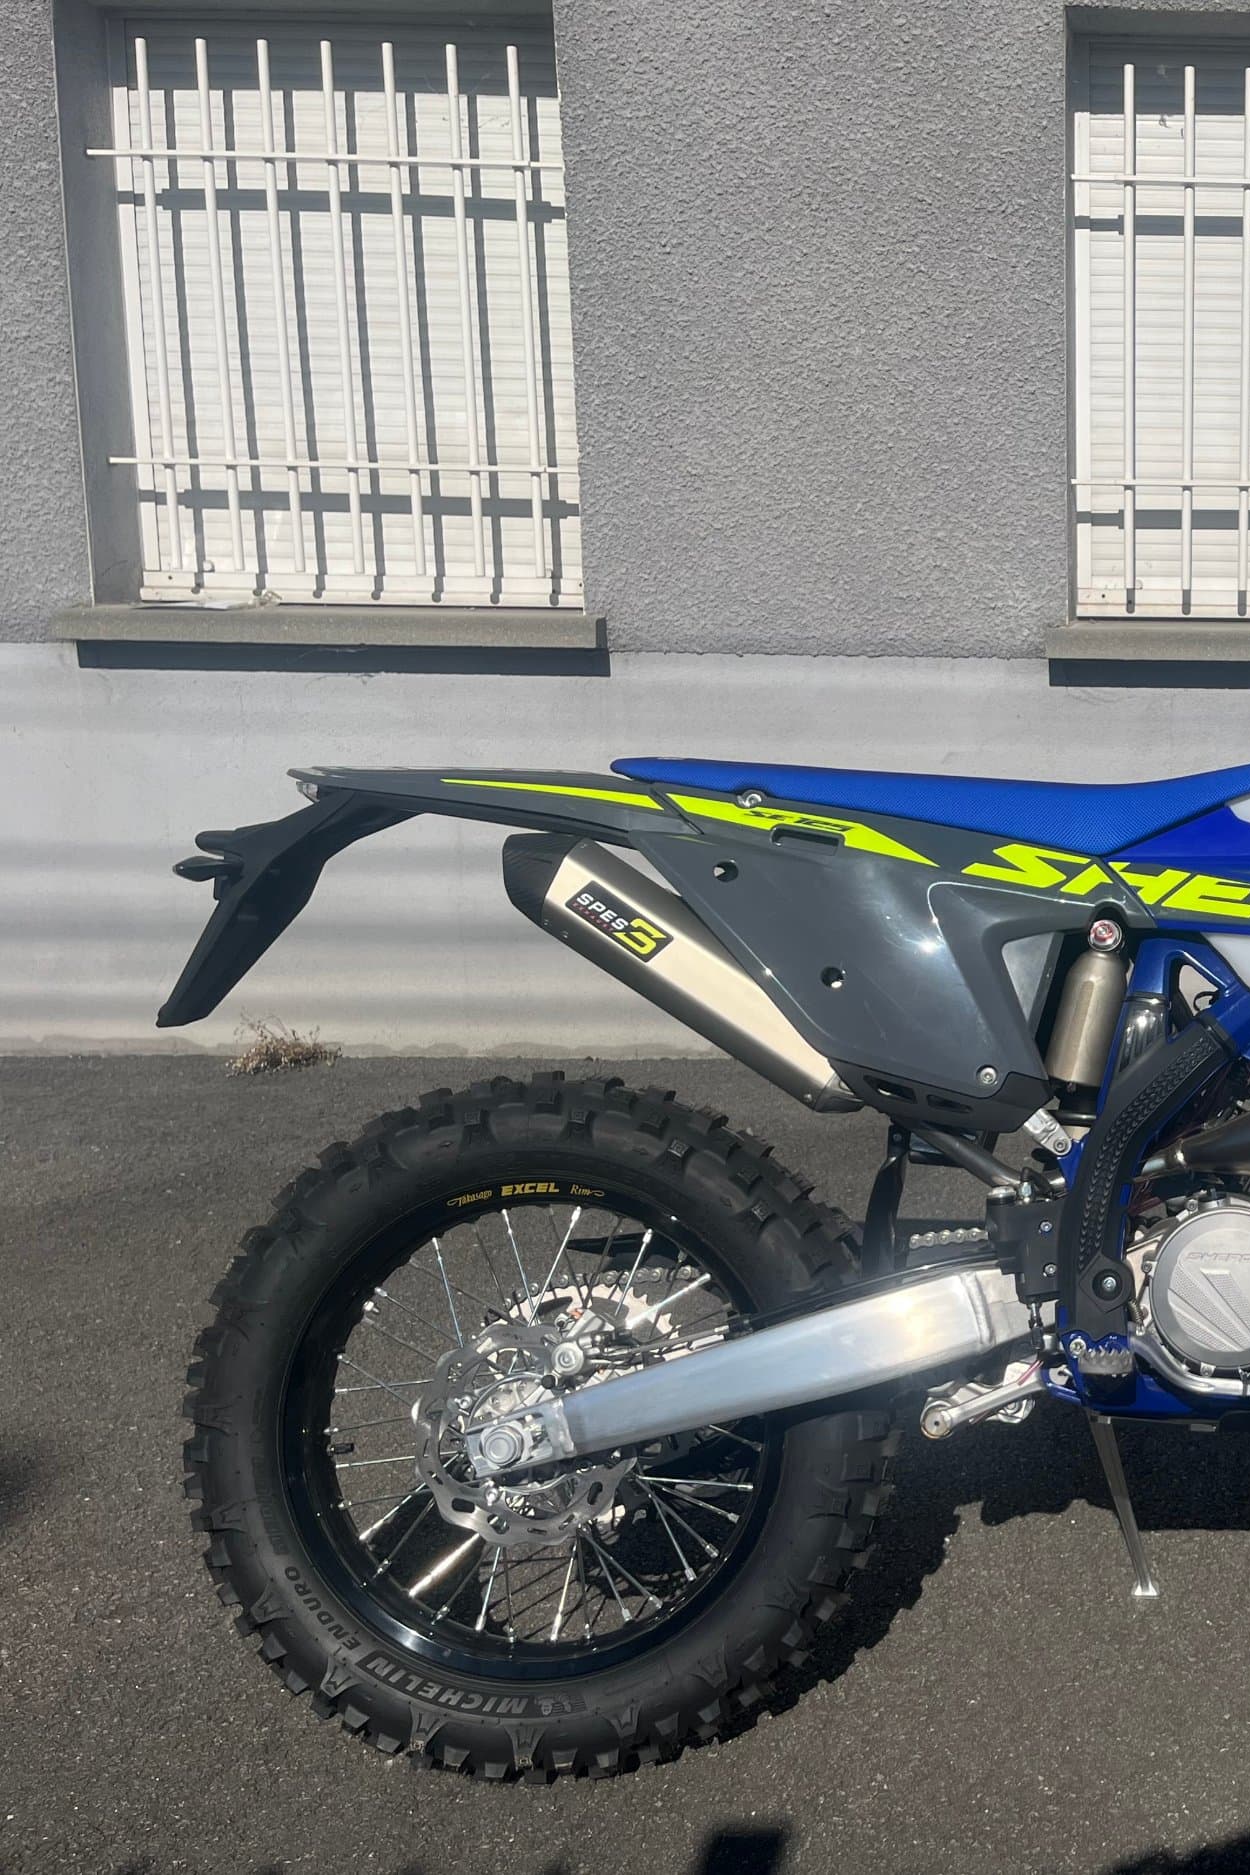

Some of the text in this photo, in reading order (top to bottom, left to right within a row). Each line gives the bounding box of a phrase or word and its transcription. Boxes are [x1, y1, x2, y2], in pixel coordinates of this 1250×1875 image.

[576, 892, 629, 931] SPES
[501, 1182, 560, 1197] EXCEL
[570, 1183, 605, 1197] Rim
[284, 1565, 363, 1650] ENDURO
[366, 1655, 529, 1715] MICHELIN
